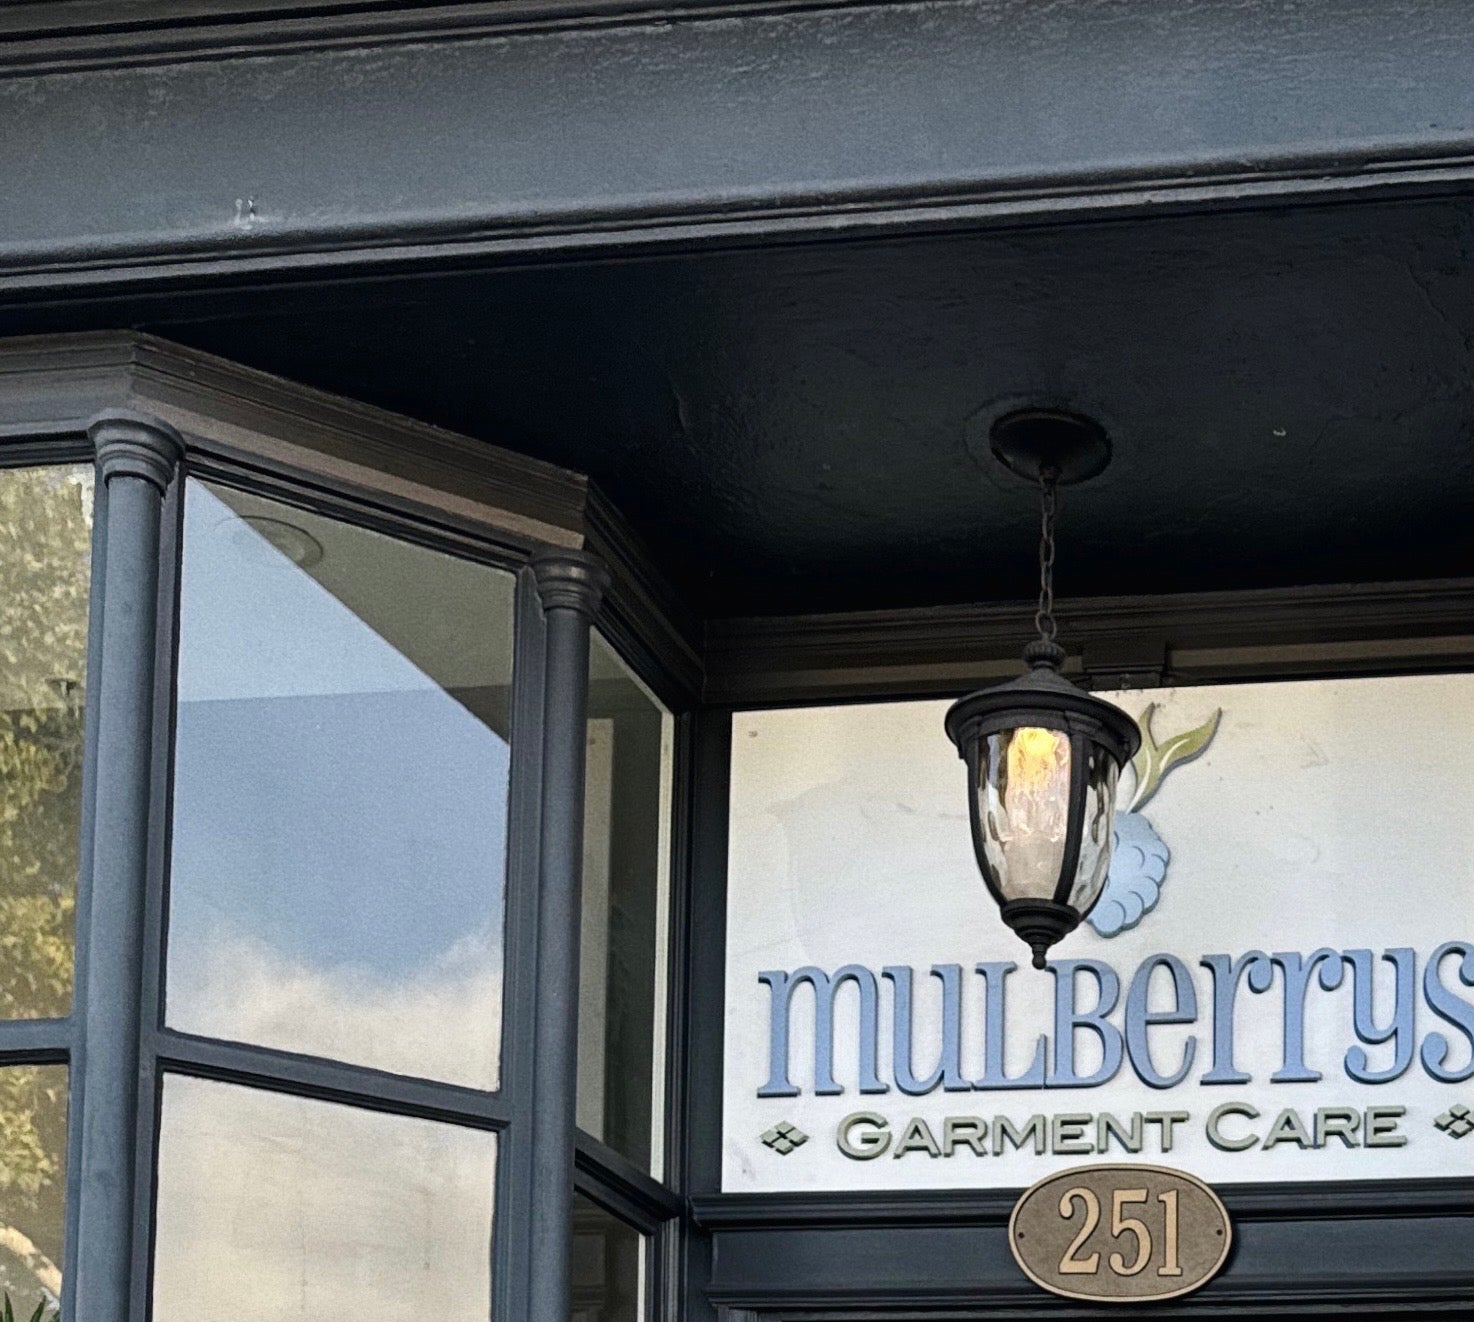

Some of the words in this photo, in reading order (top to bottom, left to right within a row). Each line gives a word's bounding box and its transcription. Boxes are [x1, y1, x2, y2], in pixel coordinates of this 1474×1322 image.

[836, 1109, 1189, 1161] GARMENT
[1205, 1101, 1408, 1154] CARE
[1057, 1186, 1183, 1277] 251
